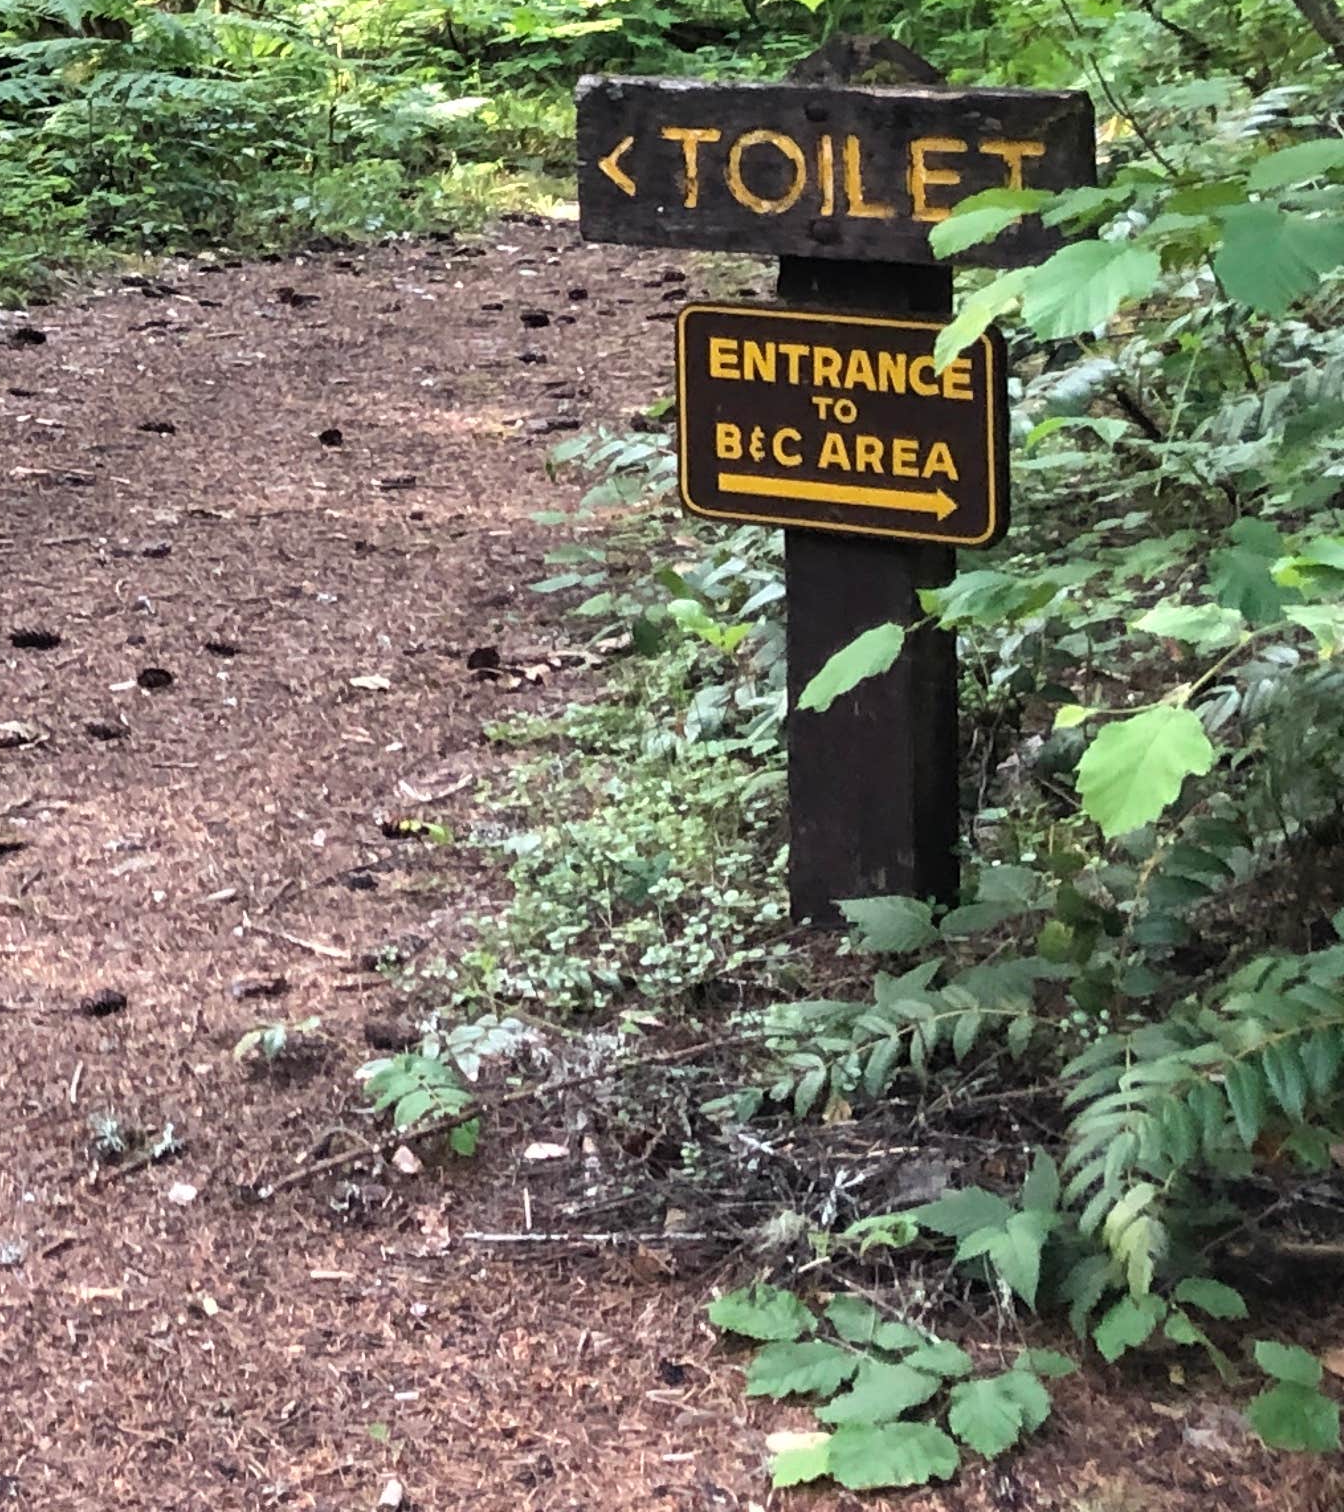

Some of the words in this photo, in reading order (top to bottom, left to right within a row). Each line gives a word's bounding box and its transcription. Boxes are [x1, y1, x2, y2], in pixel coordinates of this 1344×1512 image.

[662, 126, 1046, 224] TOILET
[709, 337, 974, 400] ENTRANCE
[812, 396, 857, 424] TO
[716, 422, 803, 468] B&C
[817, 432, 959, 482] AREA
